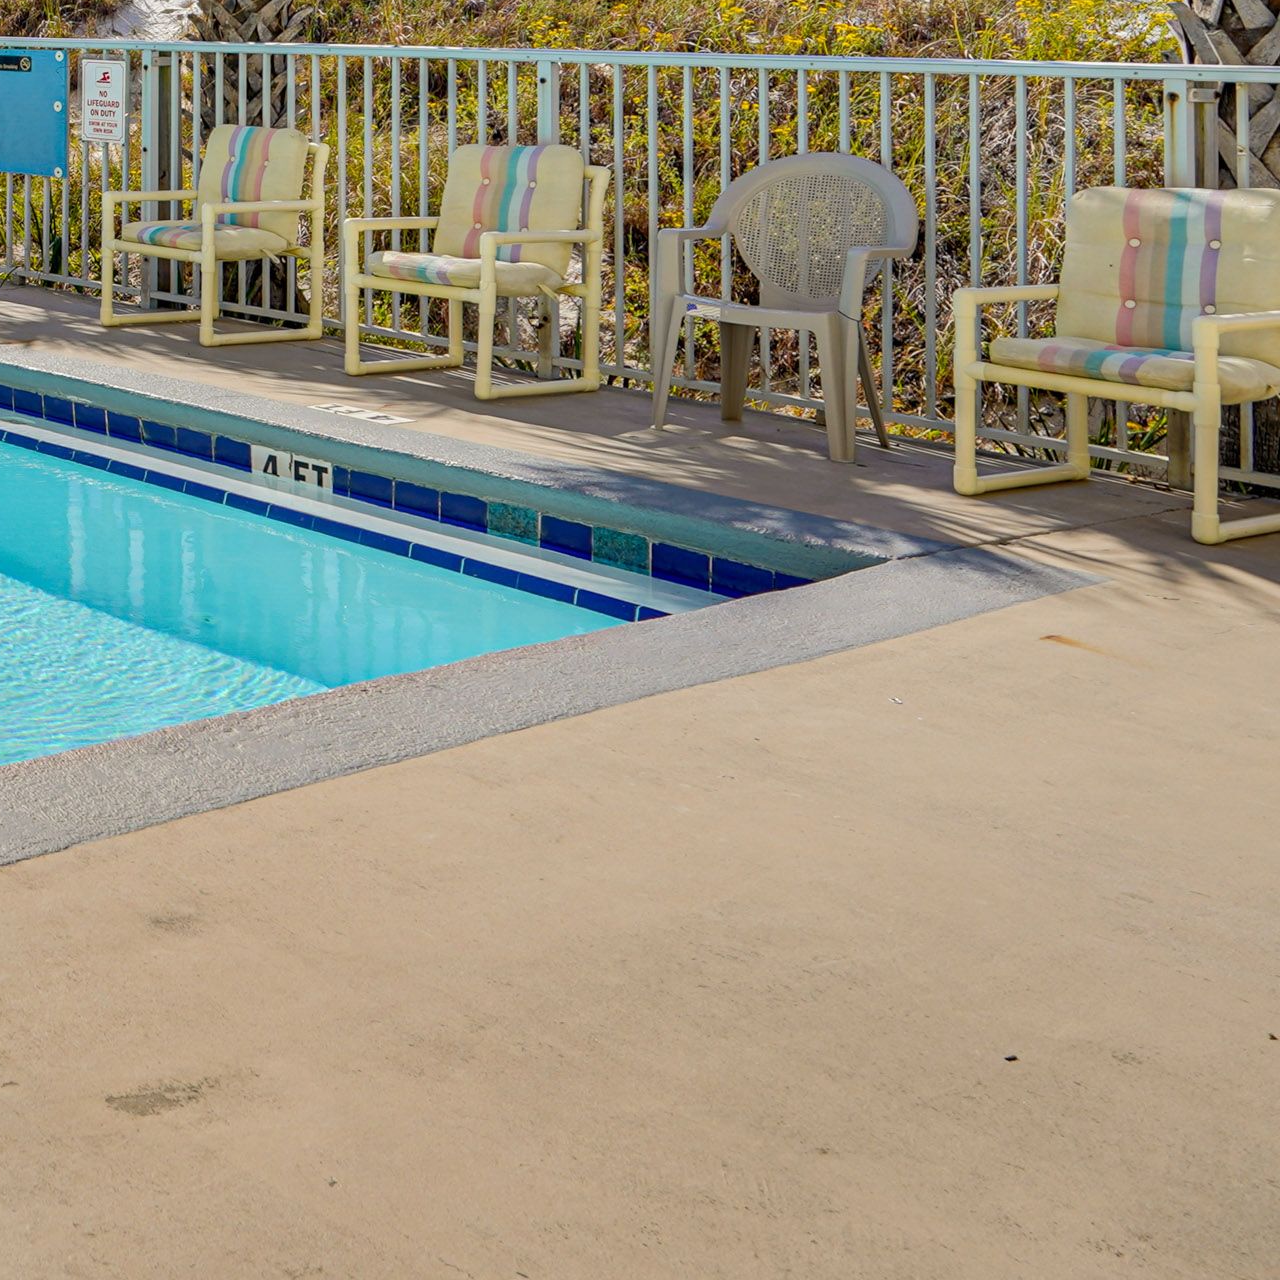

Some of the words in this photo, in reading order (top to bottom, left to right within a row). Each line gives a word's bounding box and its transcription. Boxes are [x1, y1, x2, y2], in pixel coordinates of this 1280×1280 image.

[87, 99, 120, 108] LIFEGUARD
[263, 454, 280, 477] 4
[294, 460, 328, 488] FT
